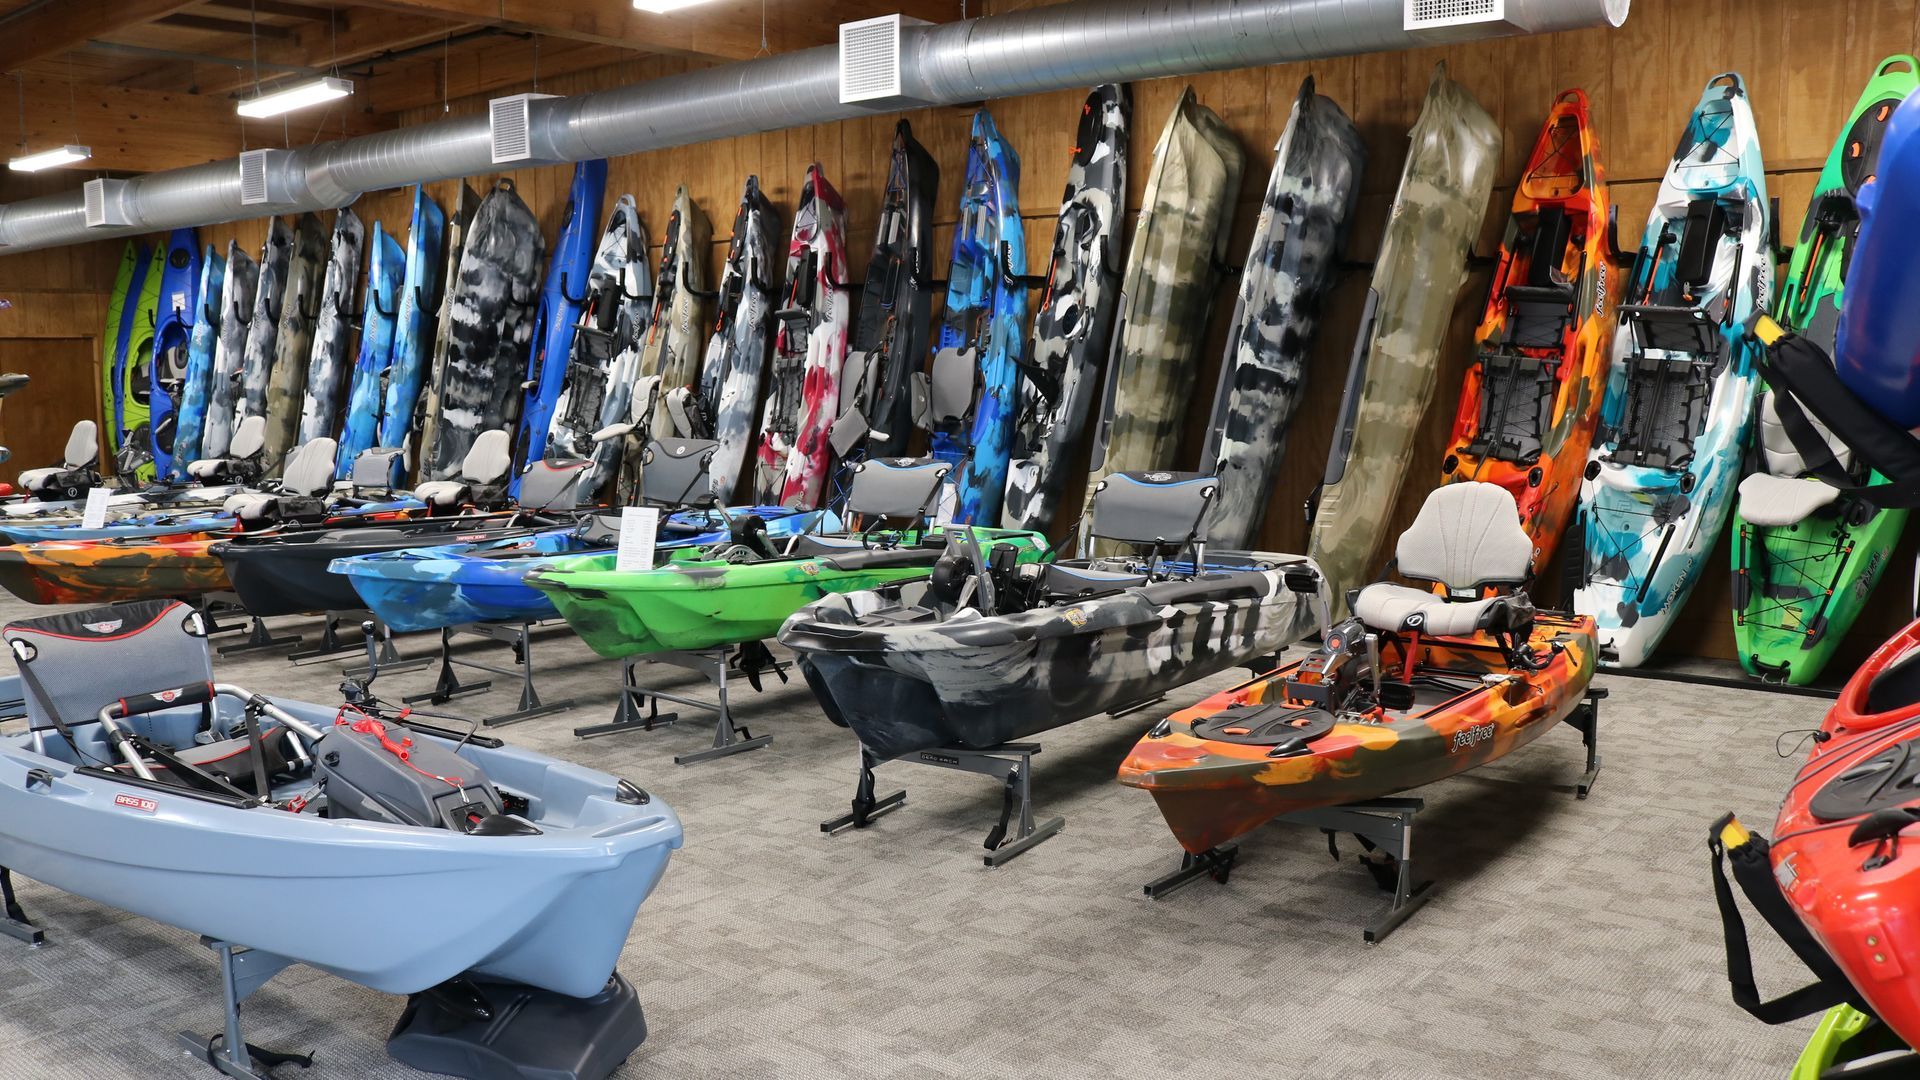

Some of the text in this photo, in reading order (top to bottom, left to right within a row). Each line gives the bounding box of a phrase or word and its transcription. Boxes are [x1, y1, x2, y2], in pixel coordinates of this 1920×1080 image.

[1595, 260, 1606, 318] feelfree
[1756, 257, 1767, 311] feelfree
[1657, 570, 1687, 615] MOKEN
[1451, 722, 1495, 753] feelfree
[116, 794, 156, 811] BASS 100
